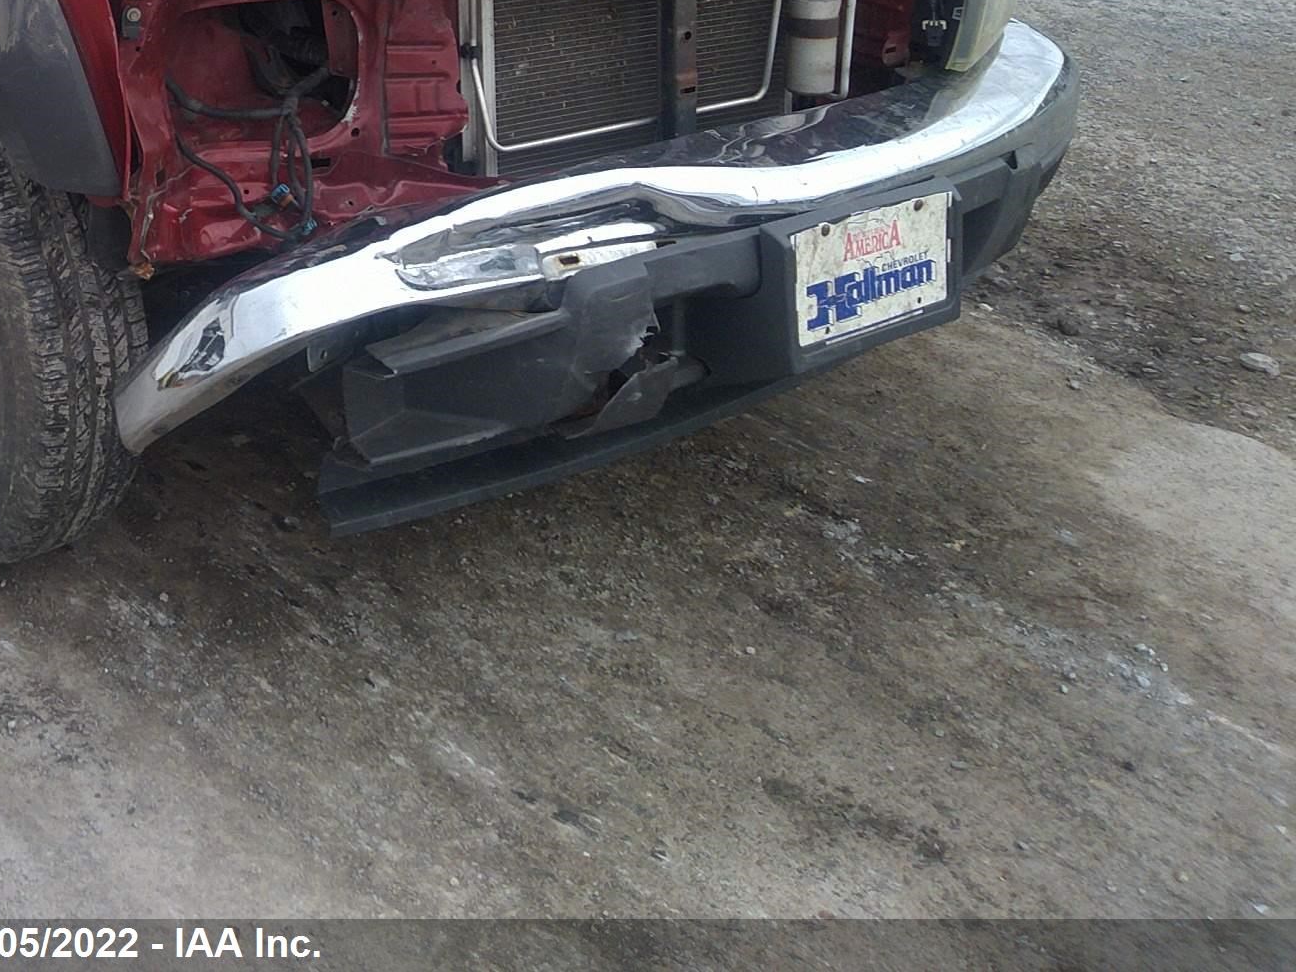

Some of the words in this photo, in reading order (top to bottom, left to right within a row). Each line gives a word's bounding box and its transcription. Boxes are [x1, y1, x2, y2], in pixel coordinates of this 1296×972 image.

[842, 219, 901, 262] AMERICA
[880, 250, 929, 272] CHEVROLET
[806, 259, 936, 331] Hallman
